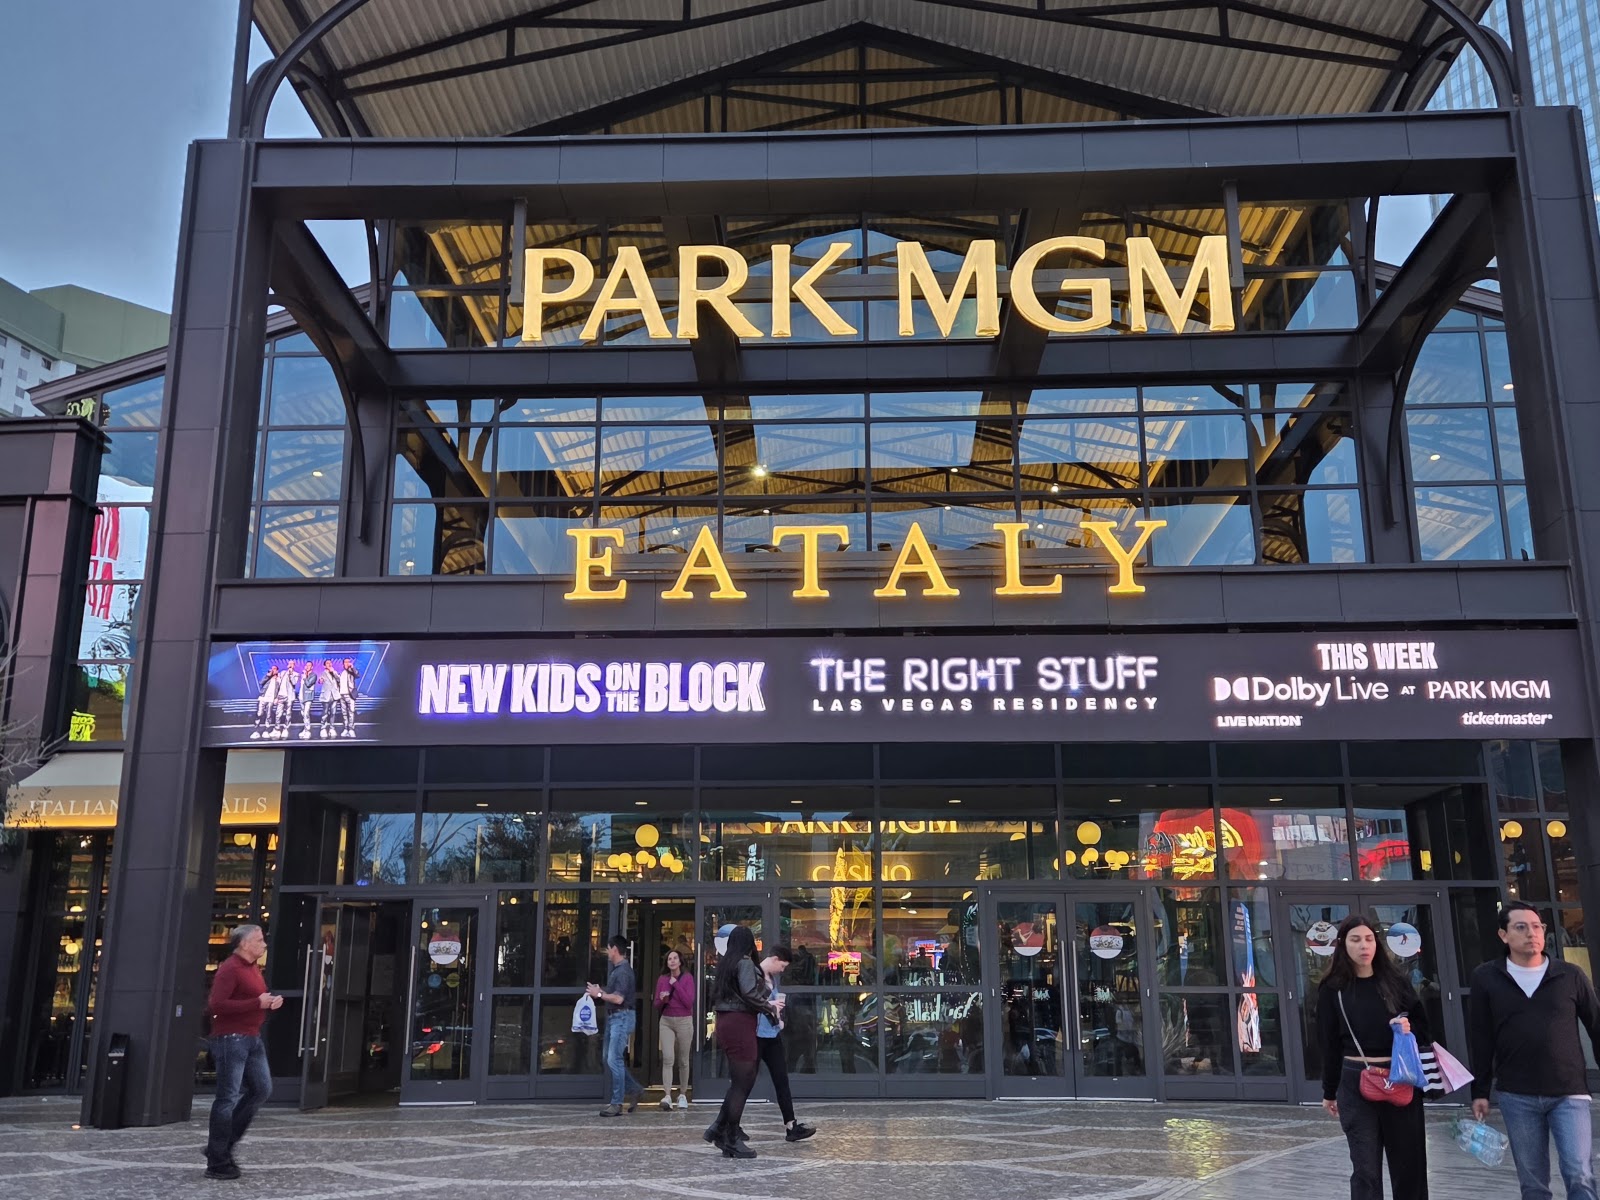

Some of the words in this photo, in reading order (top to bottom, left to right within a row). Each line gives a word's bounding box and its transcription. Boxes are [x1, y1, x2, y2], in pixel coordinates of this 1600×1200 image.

[521, 242, 858, 343] PARK
[897, 235, 1236, 337] MGM
[564, 519, 1167, 602] EATALY
[1315, 642, 1369, 671] THIS
[1373, 641, 1439, 670] WEEK
[418, 663, 508, 714] NEW
[510, 662, 602, 713] KIDS
[605, 661, 641, 691] ON
[644, 661, 767, 713] BLOCK
[809, 657, 886, 692] THE
[903, 657, 1021, 692] RIGHT
[1037, 655, 1159, 691] STUFF
[605, 691, 640, 713] THE
[812, 698, 862, 712] LAS
[881, 698, 974, 712] VEGAS
[993, 696, 1159, 711] RESIDENCY
[1252, 676, 1332, 707] Dolby
[1335, 676, 1389, 701] Live
[1400, 685, 1416, 695] AT
[1427, 680, 1487, 699] PARK
[1490, 680, 1551, 699] MGM
[1217, 715, 1247, 727] LIVE
[1247, 715, 1301, 727] NATION
[222, 796, 267, 813] AILS
